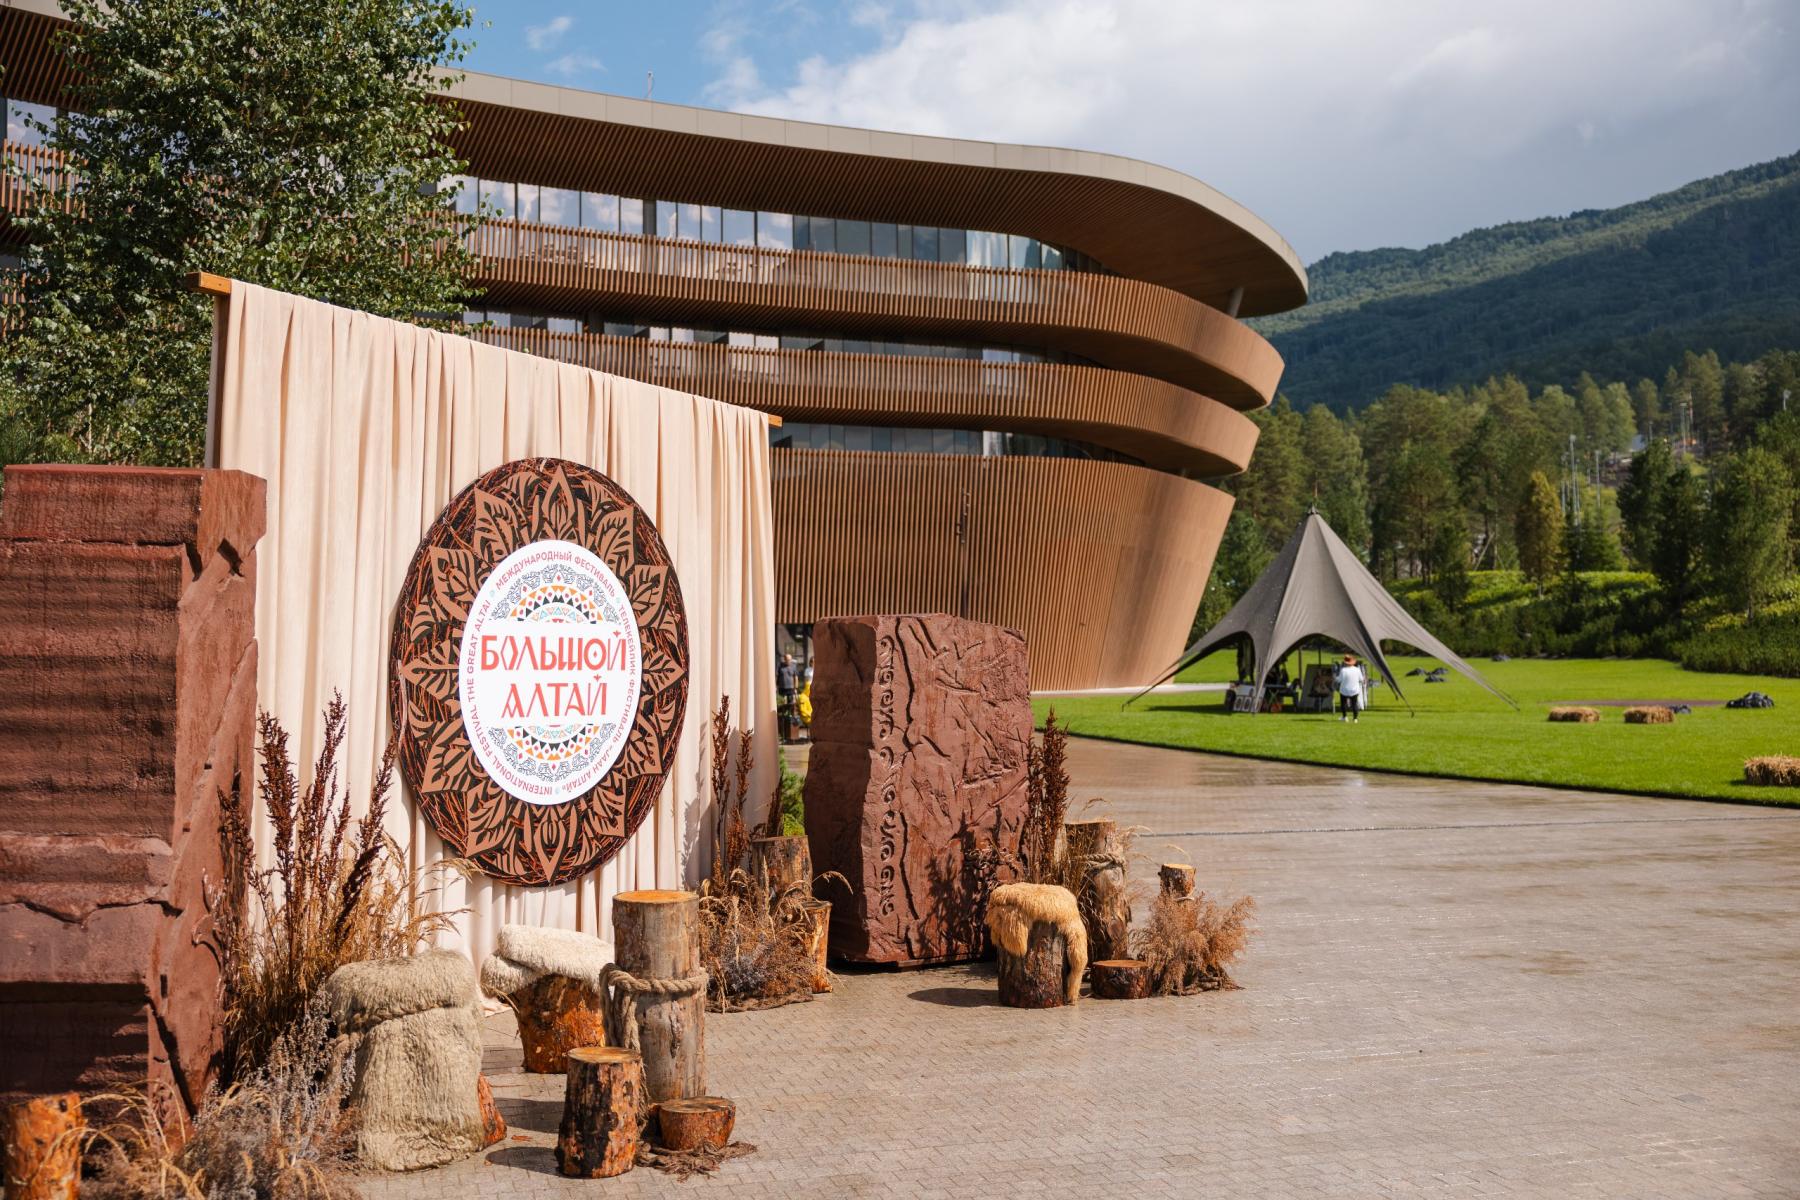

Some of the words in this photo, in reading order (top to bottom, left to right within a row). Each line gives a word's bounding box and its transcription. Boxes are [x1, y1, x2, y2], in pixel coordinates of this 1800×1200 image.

[496, 551, 572, 590] МЕЖДУНАРОДНЫЙ
[574, 556, 615, 597] ФЕСТИВАЛЬ
[474, 599, 491, 632] ALTAI
[466, 634, 478, 674] GREAT
[480, 630, 627, 671] БОЛЬШОЙ
[466, 678, 476, 703] THE
[501, 673, 608, 719] АЛТАЙ
[613, 679, 635, 743] ФЕСТИВАЛЬ
[470, 704, 493, 757] FESTIVAL
[492, 755, 553, 795] INTERNATIONAL
